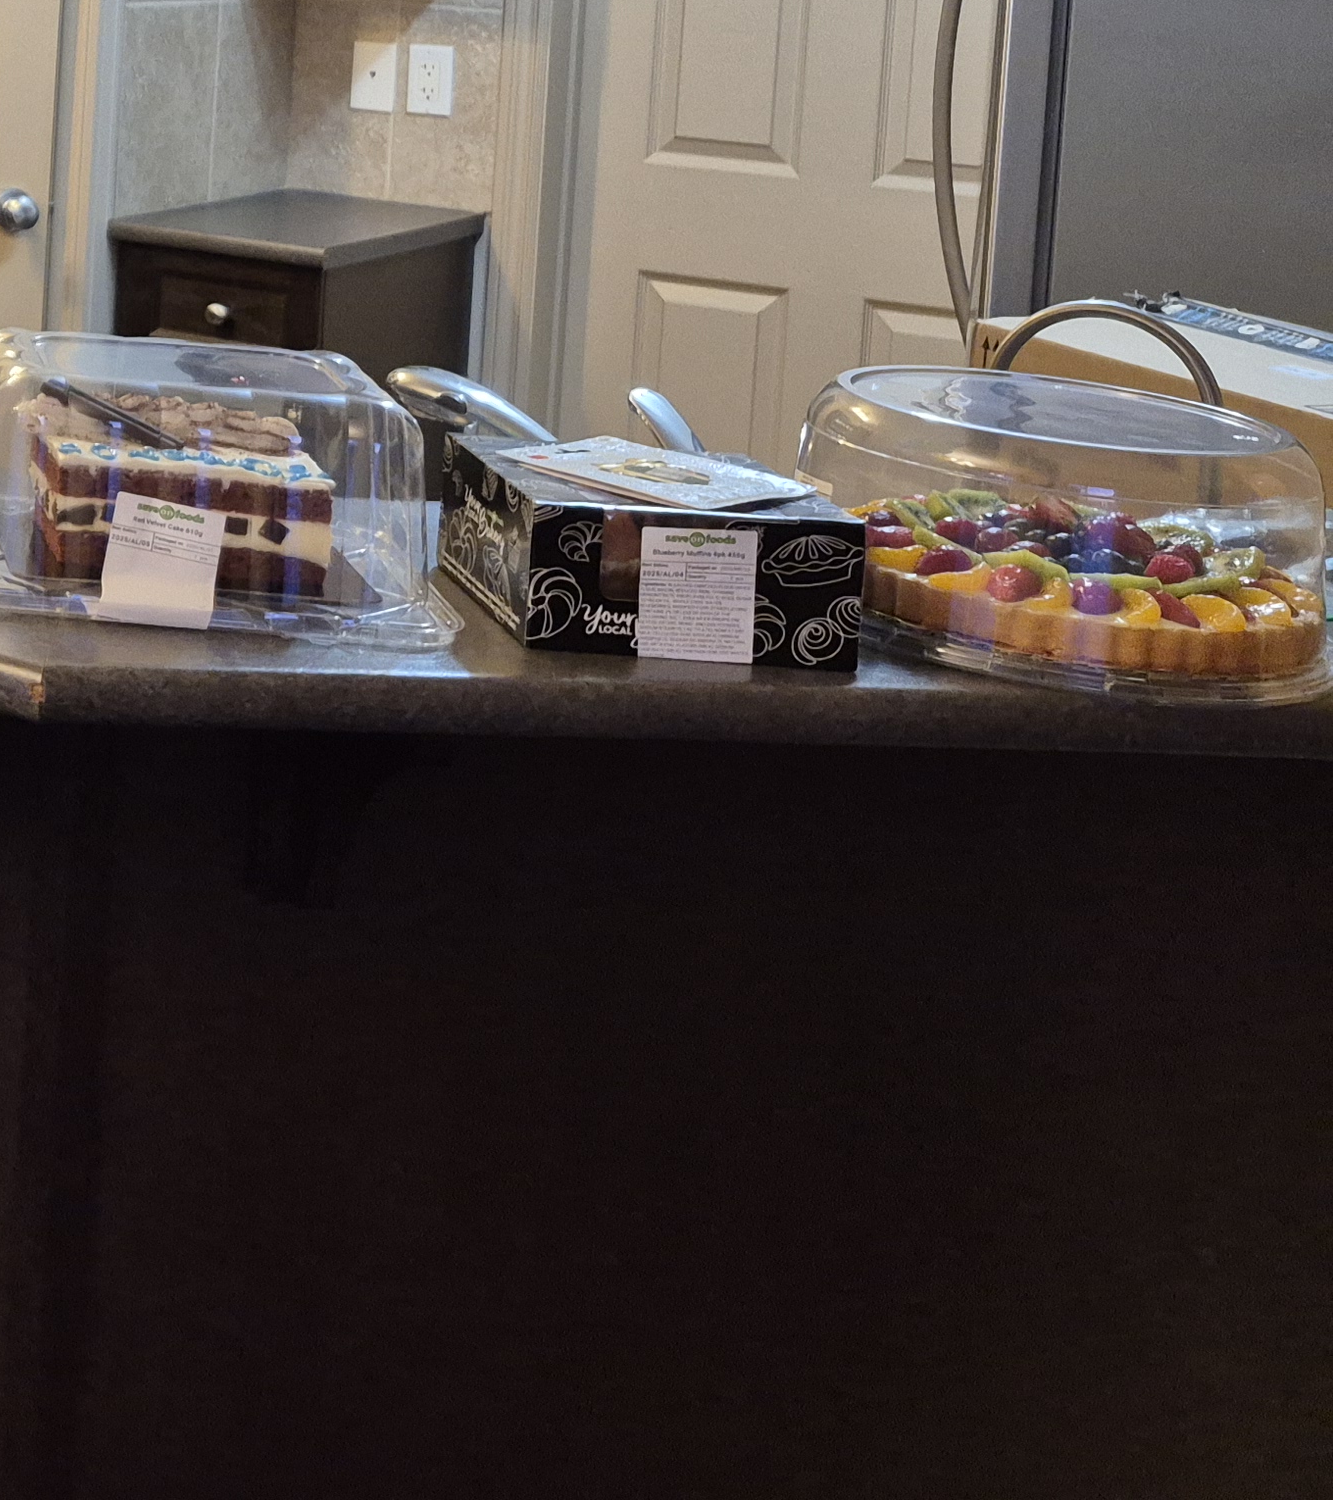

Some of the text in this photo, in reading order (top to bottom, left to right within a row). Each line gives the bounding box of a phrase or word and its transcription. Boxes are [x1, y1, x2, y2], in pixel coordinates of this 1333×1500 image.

[168, 523, 184, 532] Cake
[706, 534, 736, 545] foods
[581, 604, 637, 635] Your
[598, 624, 632, 636] LOCAL
